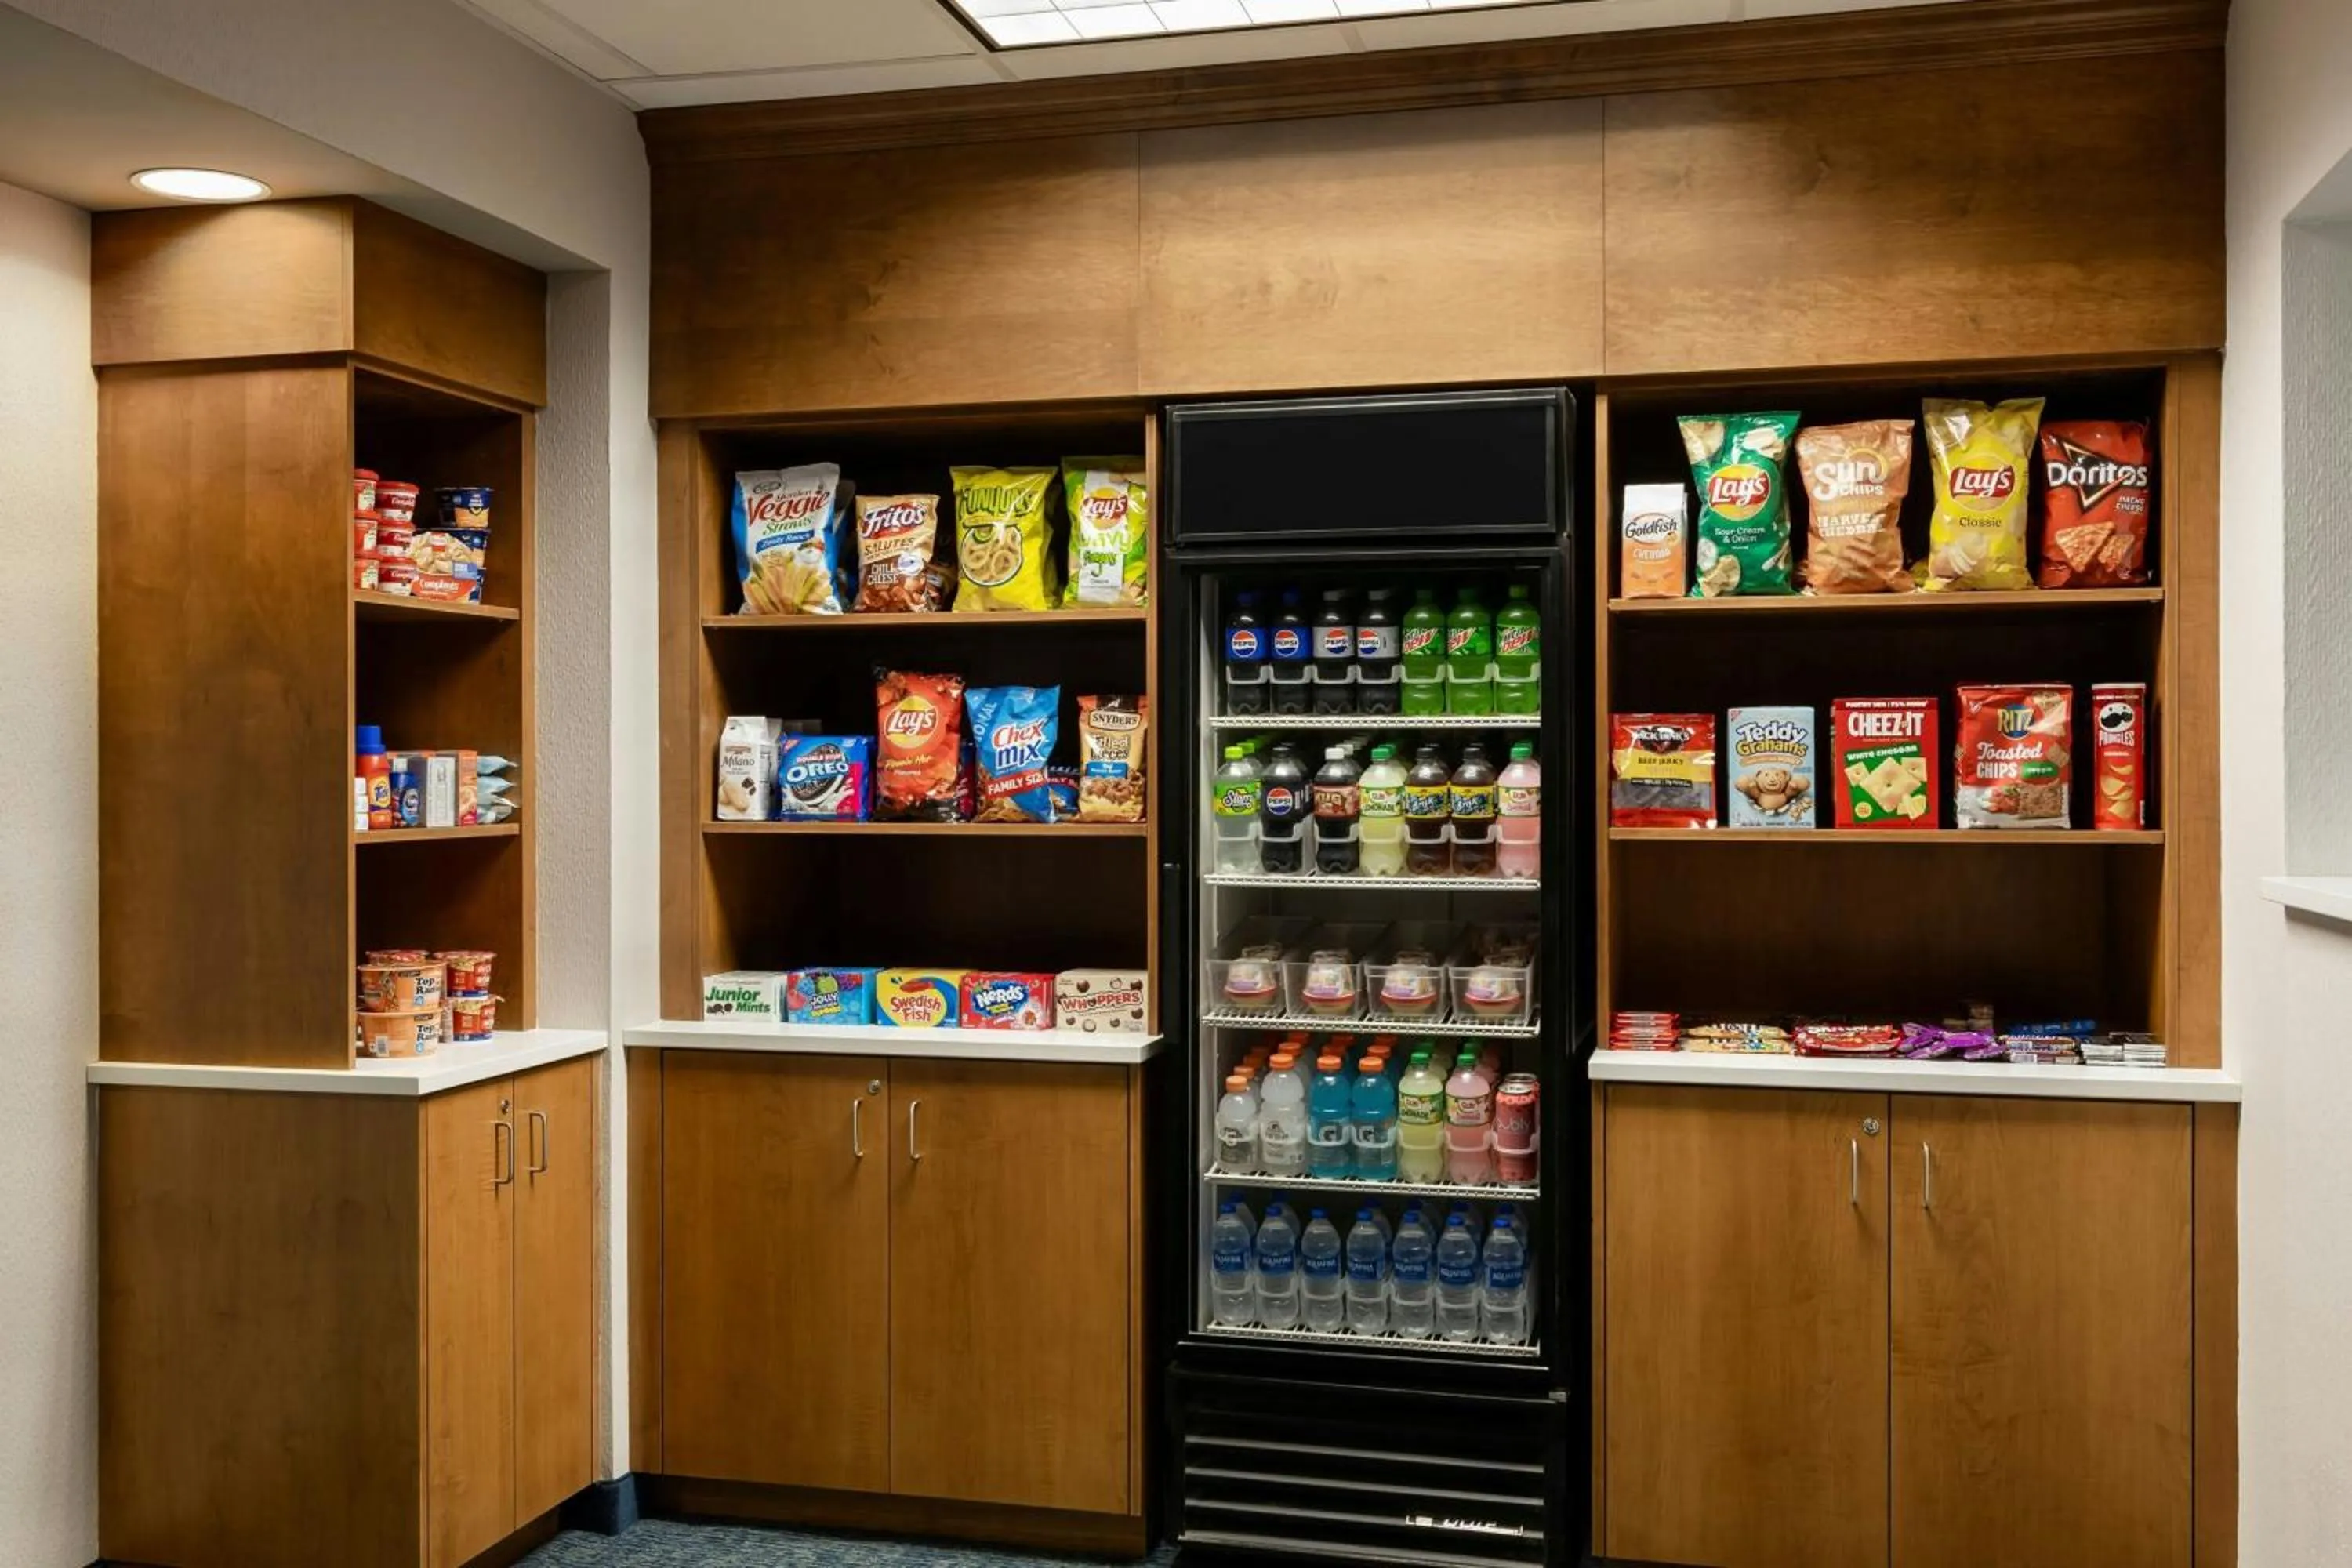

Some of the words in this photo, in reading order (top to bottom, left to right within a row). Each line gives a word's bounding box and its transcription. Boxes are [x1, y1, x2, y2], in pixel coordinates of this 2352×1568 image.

[1813, 458, 1882, 501] Sun
[1953, 466, 2012, 498] Lay's
[2046, 460, 2148, 488] Doritos
[1711, 471, 1767, 506] Lay's
[747, 489, 831, 528] Veggie
[1624, 517, 1678, 539] Goldfish
[1737, 526, 1766, 535] Cream
[1959, 515, 2002, 528] Classic
[887, 707, 936, 735] Lay's
[1998, 707, 2035, 733] RITZ
[993, 717, 1048, 748] Chex
[1736, 720, 1808, 743] Teddy
[1736, 739, 1808, 757] Grahams
[1976, 741, 2043, 760] Toasted
[720, 755, 756, 768] Milano
[786, 761, 849, 782] OREO
[1976, 761, 2018, 779] CHIPS
[987, 776, 1023, 795] FAMILY
[1024, 772, 1047, 786] SIZ
[705, 987, 761, 1002] Junior
[890, 993, 942, 1013] Swedish
[1062, 990, 1142, 1011] WHOPPERS
[735, 1002, 771, 1014] Mints
[903, 1007, 932, 1022] Fish
